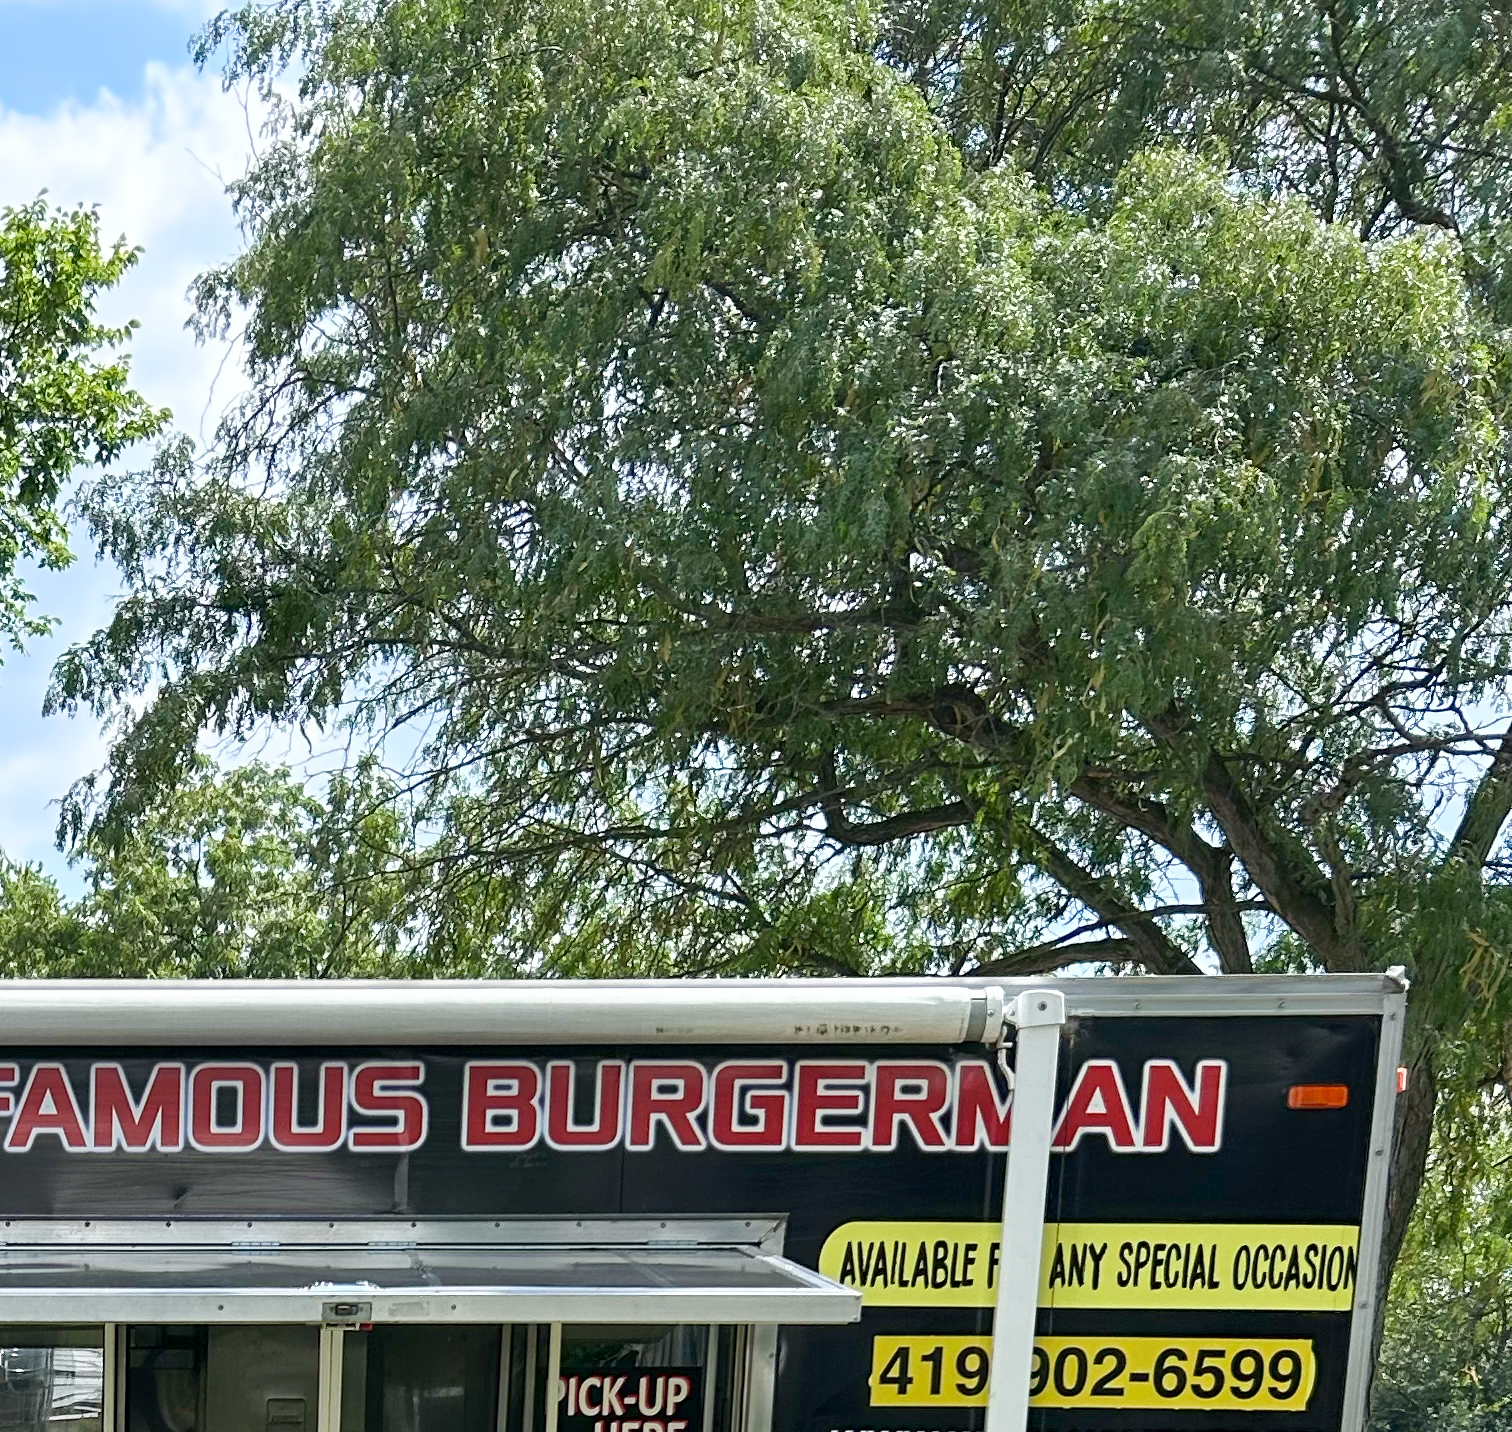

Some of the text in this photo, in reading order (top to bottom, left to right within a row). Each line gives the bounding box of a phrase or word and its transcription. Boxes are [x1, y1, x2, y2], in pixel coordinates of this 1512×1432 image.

[840, 1240, 978, 1289] AVAILABLE
[1049, 1242, 1108, 1290] ANY
[1117, 1241, 1220, 1291] SPECIAL
[879, 1346, 1303, 1400] 419902-6599
